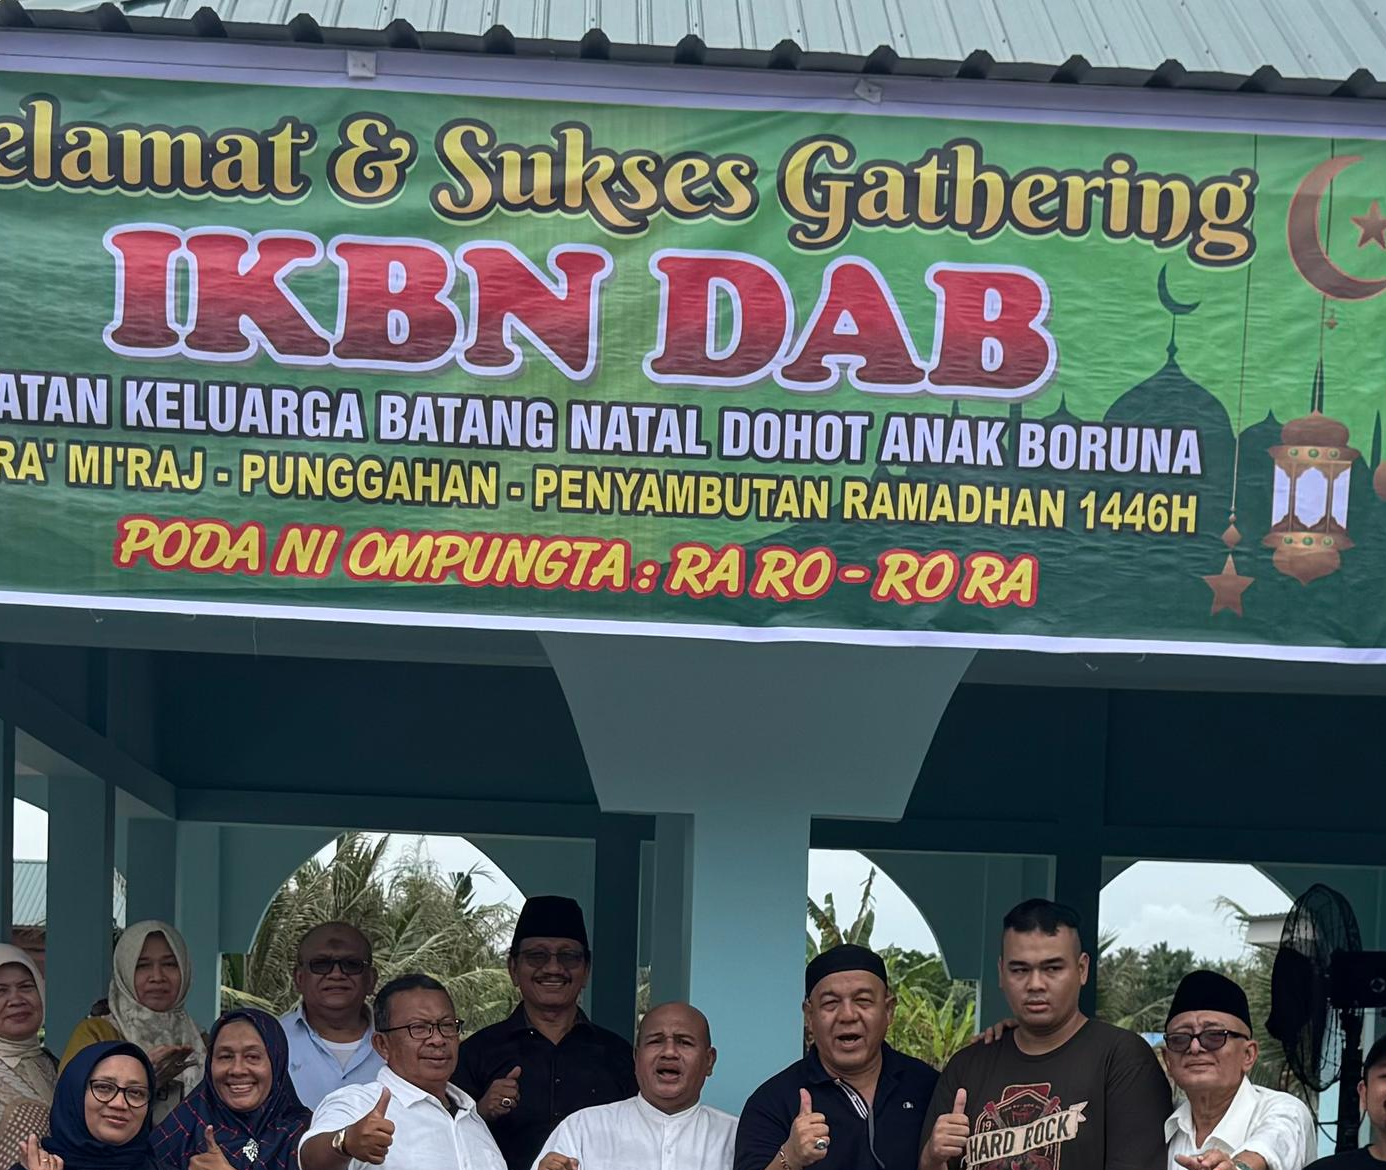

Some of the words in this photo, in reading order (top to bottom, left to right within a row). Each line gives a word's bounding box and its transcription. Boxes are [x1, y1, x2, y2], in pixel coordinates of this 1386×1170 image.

[334, 118, 410, 198] &
[439, 125, 755, 229] Sukses
[783, 140, 1255, 262] Gathering
[104, 225, 612, 380] IKBN
[644, 249, 1060, 397] DAB
[124, 379, 365, 440] KELUARGA
[379, 394, 554, 449] BATANG
[570, 403, 708, 456] NATAL
[722, 411, 869, 462] DOHOT
[881, 416, 1005, 467] ANAK
[1018, 423, 1202, 476] BORUNA
[68, 444, 204, 490] MI'RAJ
[242, 453, 497, 505] PUNGGAHAN
[535, 469, 829, 520] PENYAMBUTAN
[843, 480, 1065, 528] RAMADHAN
[1079, 490, 1197, 533] 1446H
[118, 518, 260, 570] PODA
[275, 527, 338, 574] NI
[348, 531, 626, 588] OMPUNGTA
[669, 545, 742, 594] RA
[755, 549, 832, 598] RO
[876, 552, 955, 601] RO
[962, 555, 1034, 604] RA
[969, 1130, 1016, 1164] HARD
[1022, 1113, 1071, 1151] ROCK
